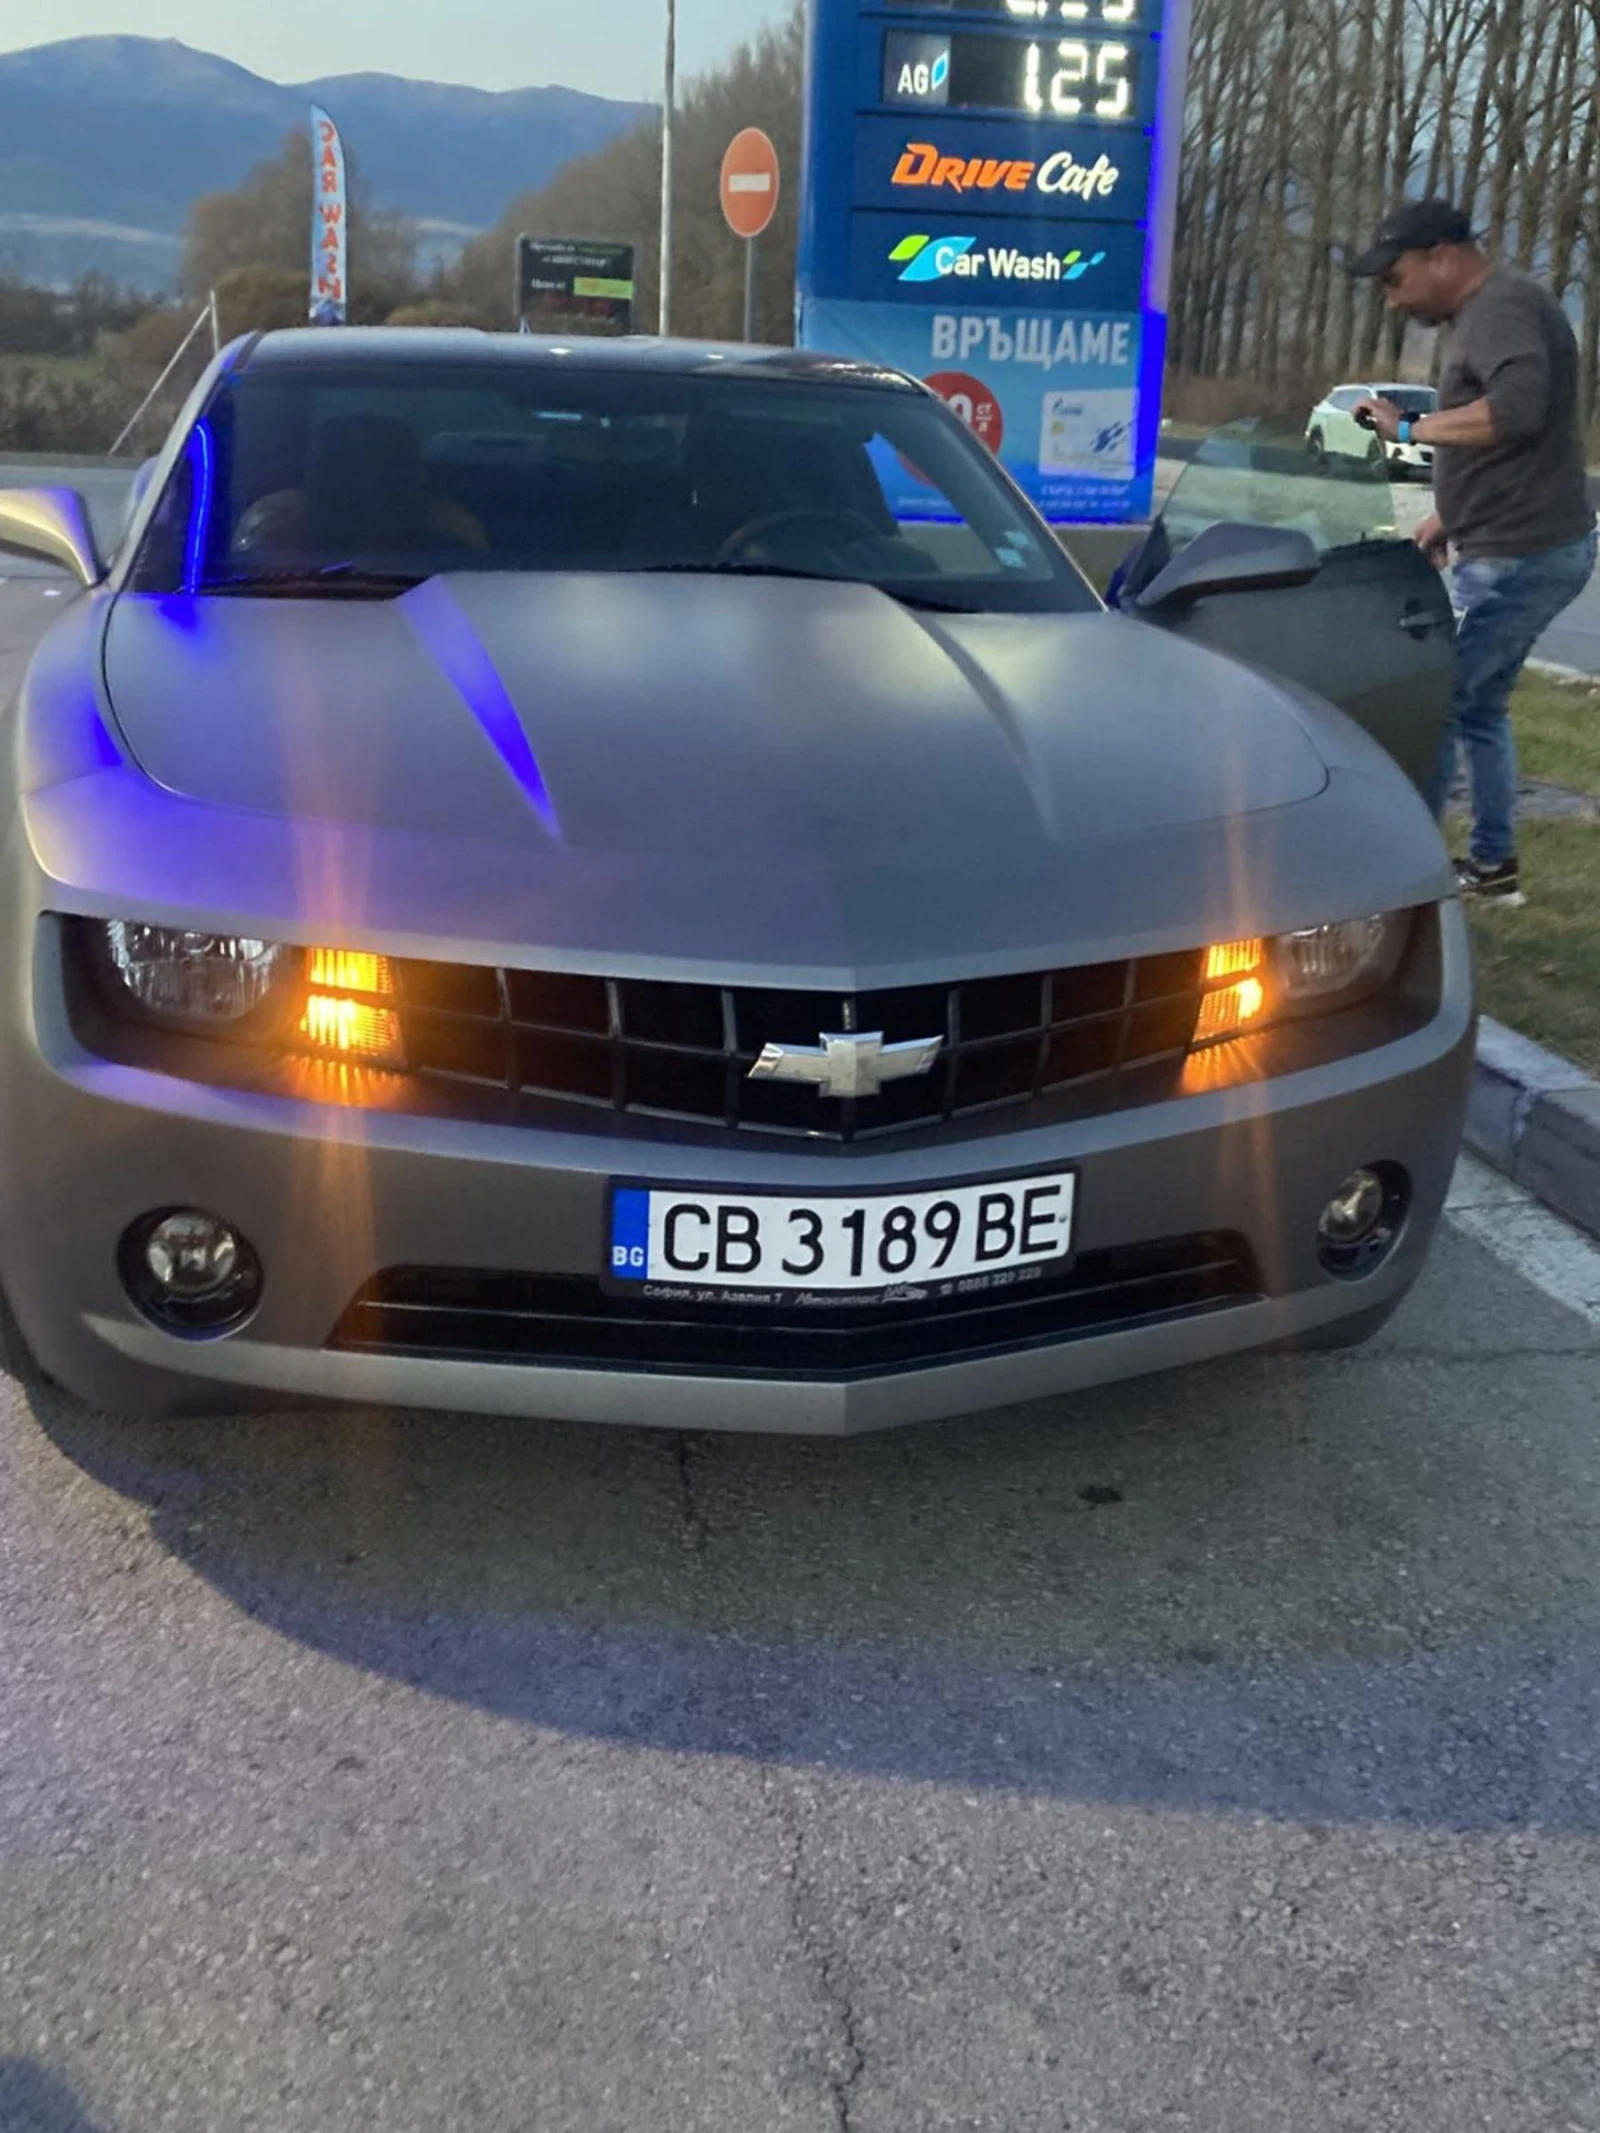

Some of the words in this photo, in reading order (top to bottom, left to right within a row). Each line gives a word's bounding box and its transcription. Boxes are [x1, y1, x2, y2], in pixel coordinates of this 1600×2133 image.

[891, 143, 1036, 193] DRIVE
[1036, 150, 1119, 201] Cafe
[935, 245, 985, 276] Car
[988, 247, 1061, 280] Wash
[931, 314, 1131, 371] ВРЪЩАМЕ
[612, 1245, 644, 1267] BG
[663, 1203, 762, 1274] CB
[781, 1200, 961, 1277] 3189
[974, 1185, 1061, 1263] BE
